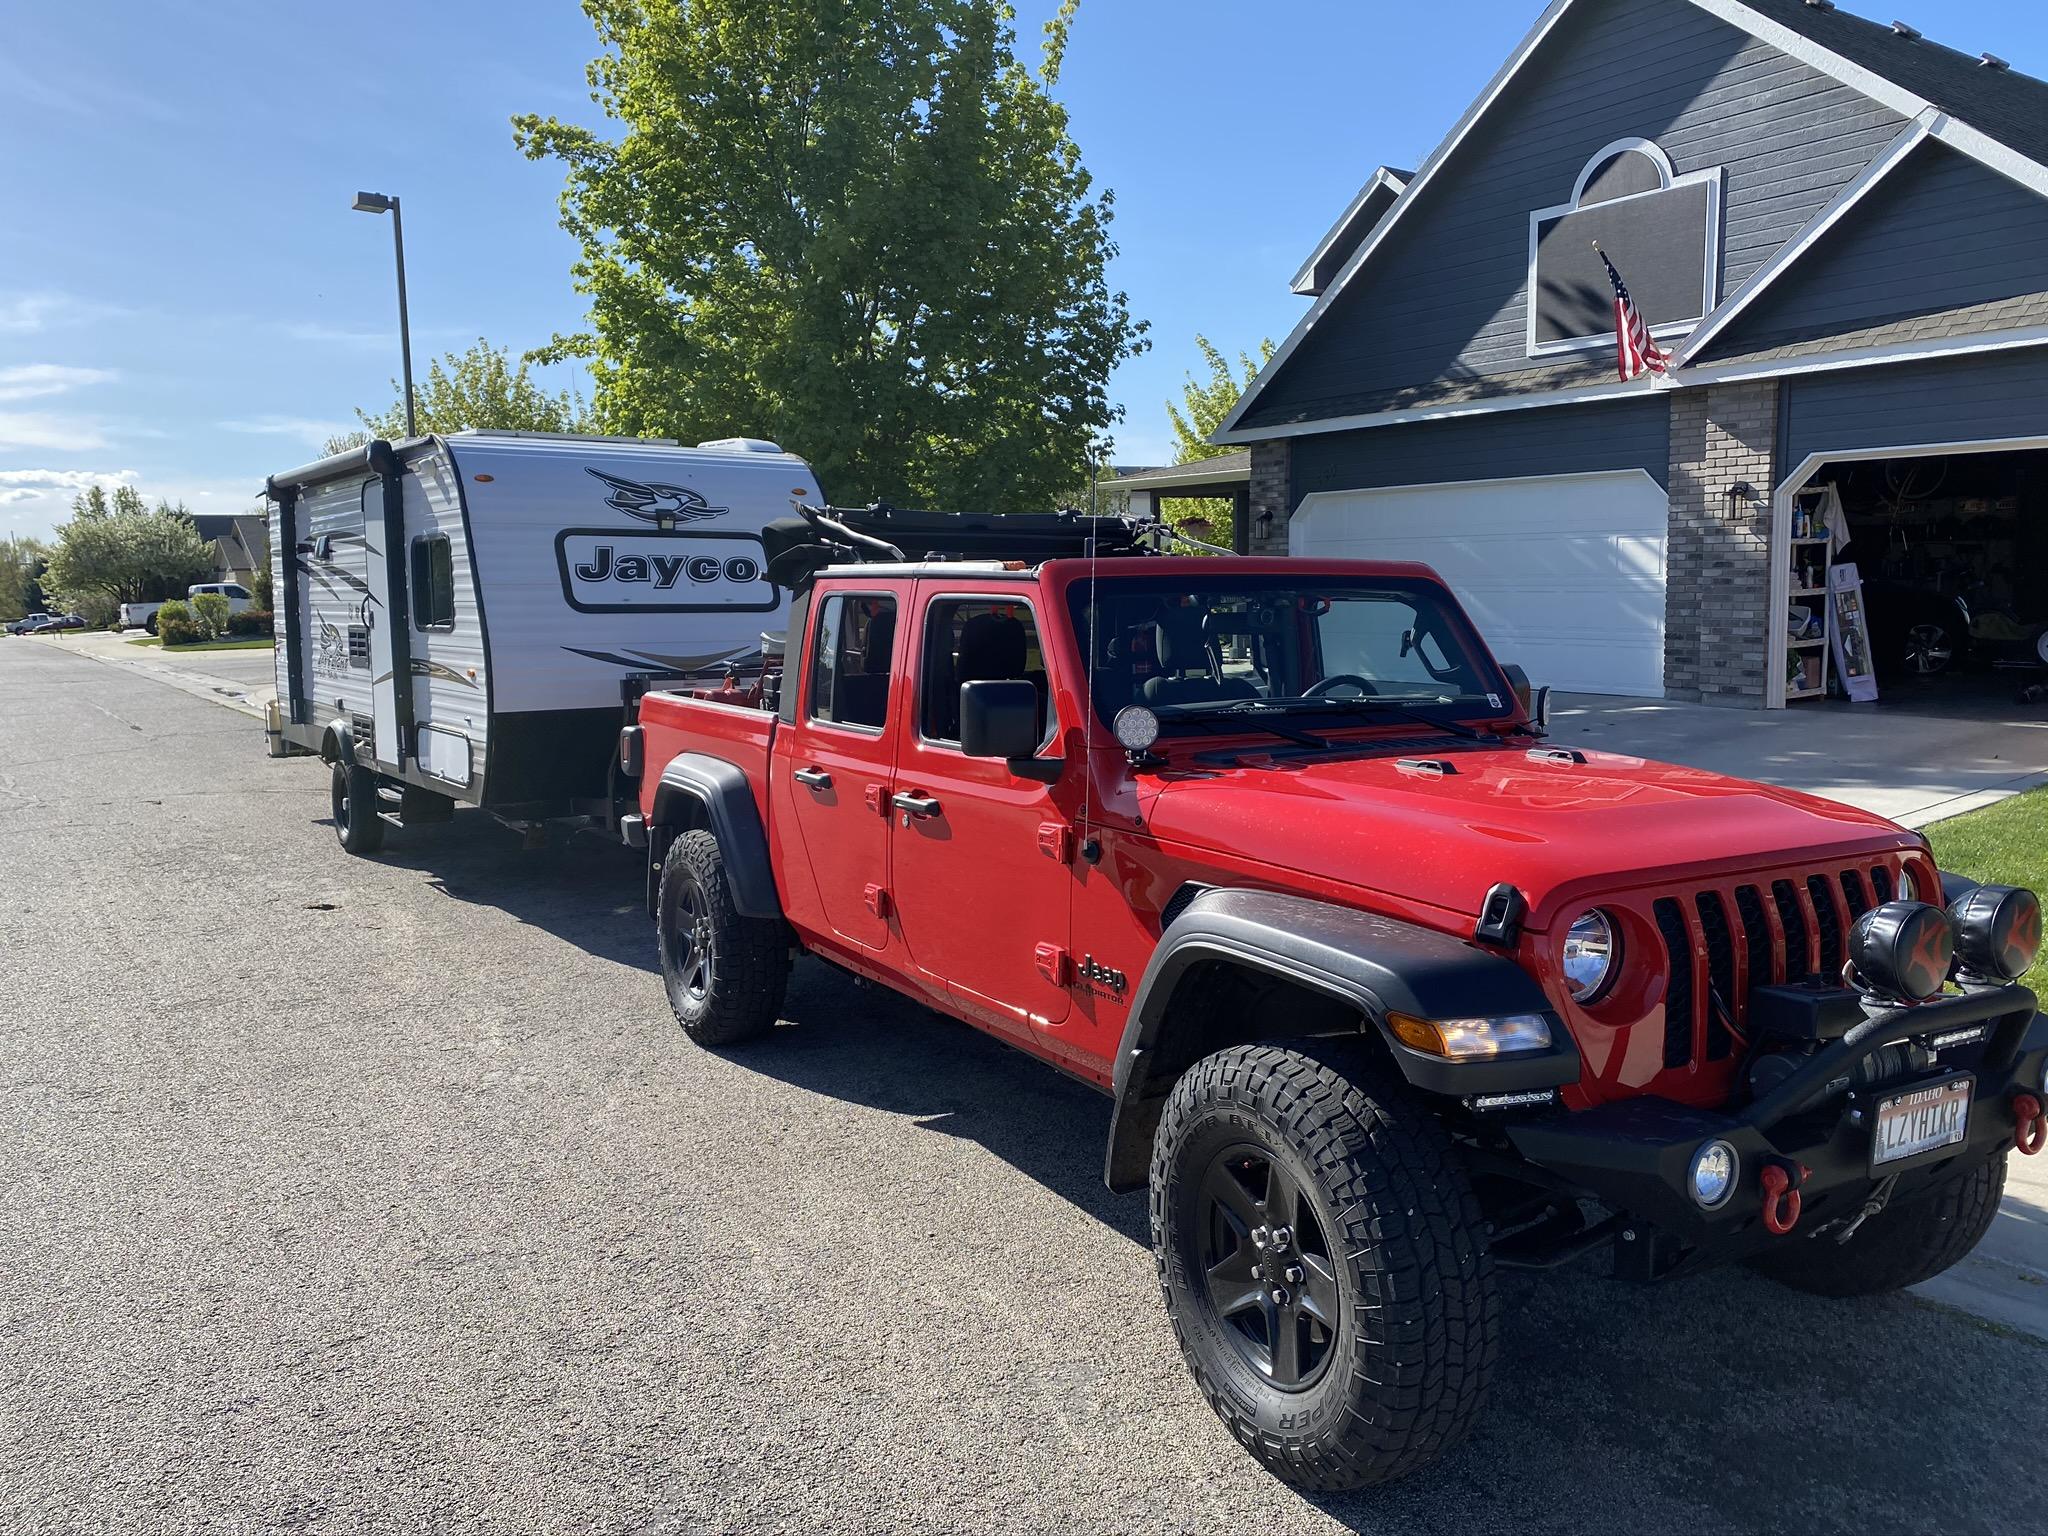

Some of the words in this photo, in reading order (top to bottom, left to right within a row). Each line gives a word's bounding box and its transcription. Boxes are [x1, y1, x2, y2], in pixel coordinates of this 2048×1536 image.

[575, 545, 759, 589] Jayco
[1078, 953, 1126, 993] Jeep
[1909, 1087, 1943, 1105] IDAHO
[1887, 1100, 1959, 1149] LZYHIKR
